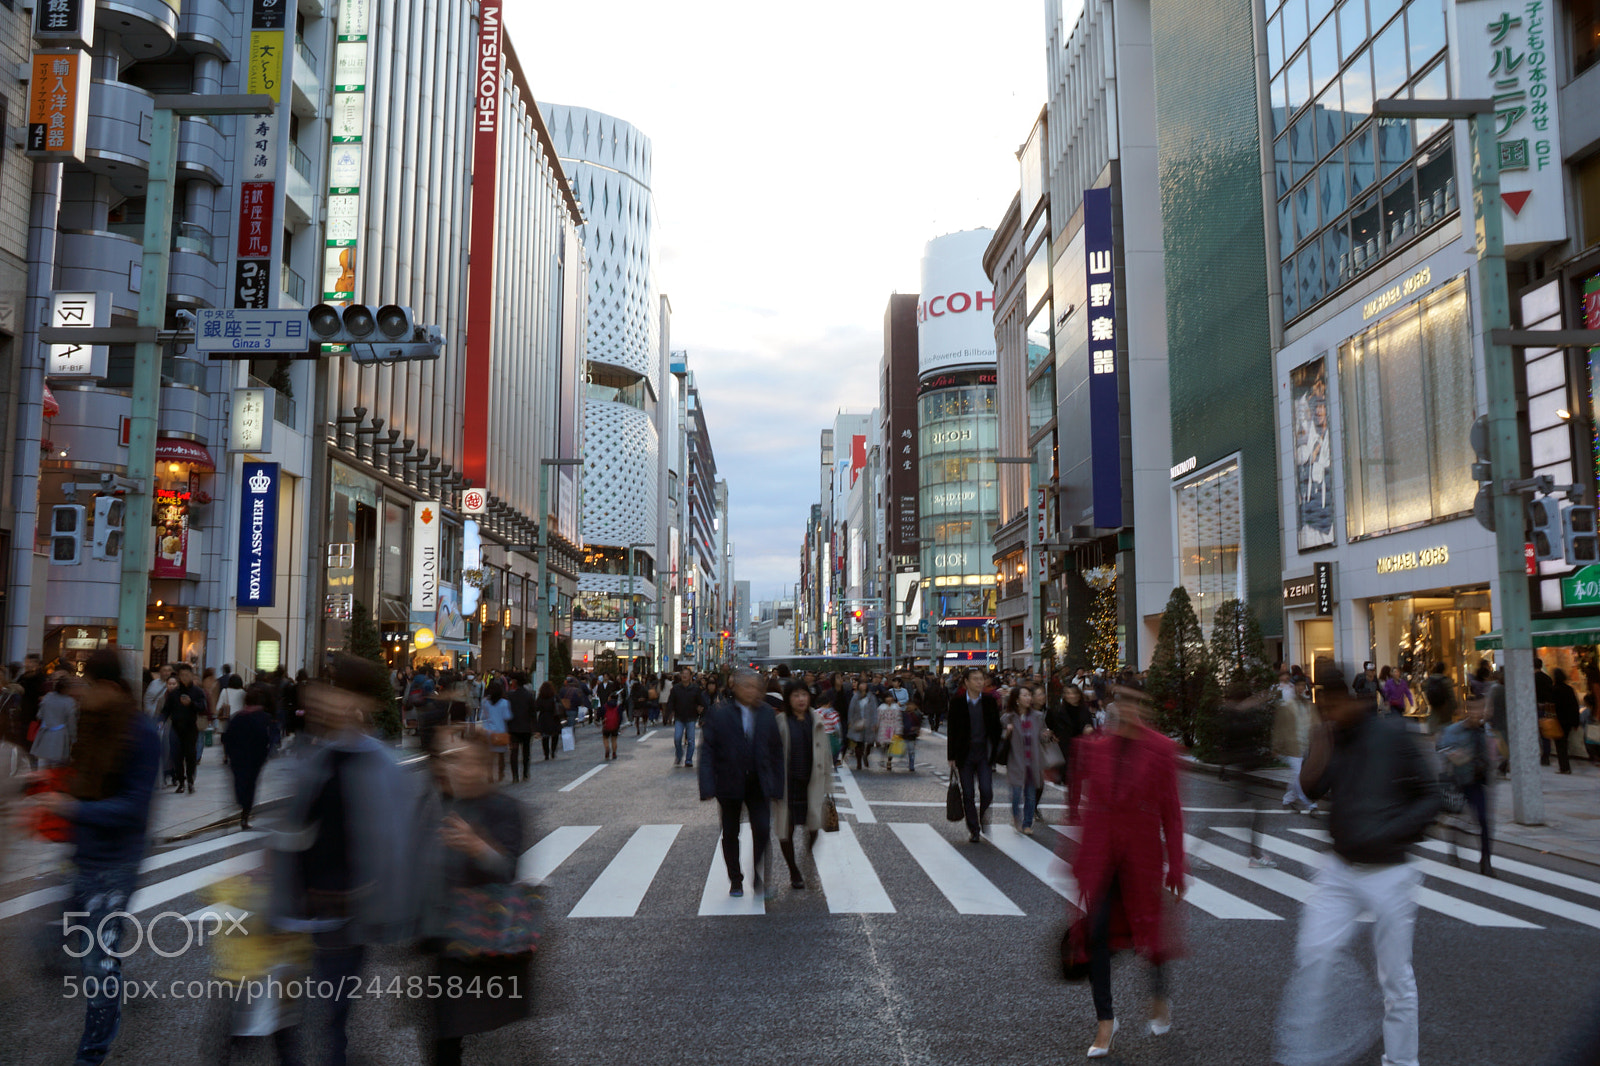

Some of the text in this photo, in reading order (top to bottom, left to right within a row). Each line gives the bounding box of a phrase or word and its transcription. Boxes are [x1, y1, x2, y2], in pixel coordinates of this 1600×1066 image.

[479, 6, 499, 132] MITSUKOSHI
[1524, 1, 1550, 132] 子どもの本のみせ
[48, 58, 71, 147] 輸入洋食器
[34, 125, 44, 148] 4F
[1363, 265, 1432, 321] MICHAEL KORS
[204, 311, 235, 319] 中央区
[1089, 250, 1114, 375] 山野楽器
[203, 320, 302, 338] 銀座三丁目
[232, 338, 271, 350] Ginza 3
[964, 349, 996, 357] Billboar
[979, 375, 997, 383] RIC
[1170, 455, 1197, 479] MIKIMOTO
[157, 497, 182, 505] CAKES
[249, 498, 264, 600] ROYAL ASSCHER
[1377, 543, 1450, 575] MICHAEL KORS
[1289, 582, 1315, 598] ZENIT
[1320, 571, 1329, 607] ZENITH
[1573, 579, 1600, 601] 本の
